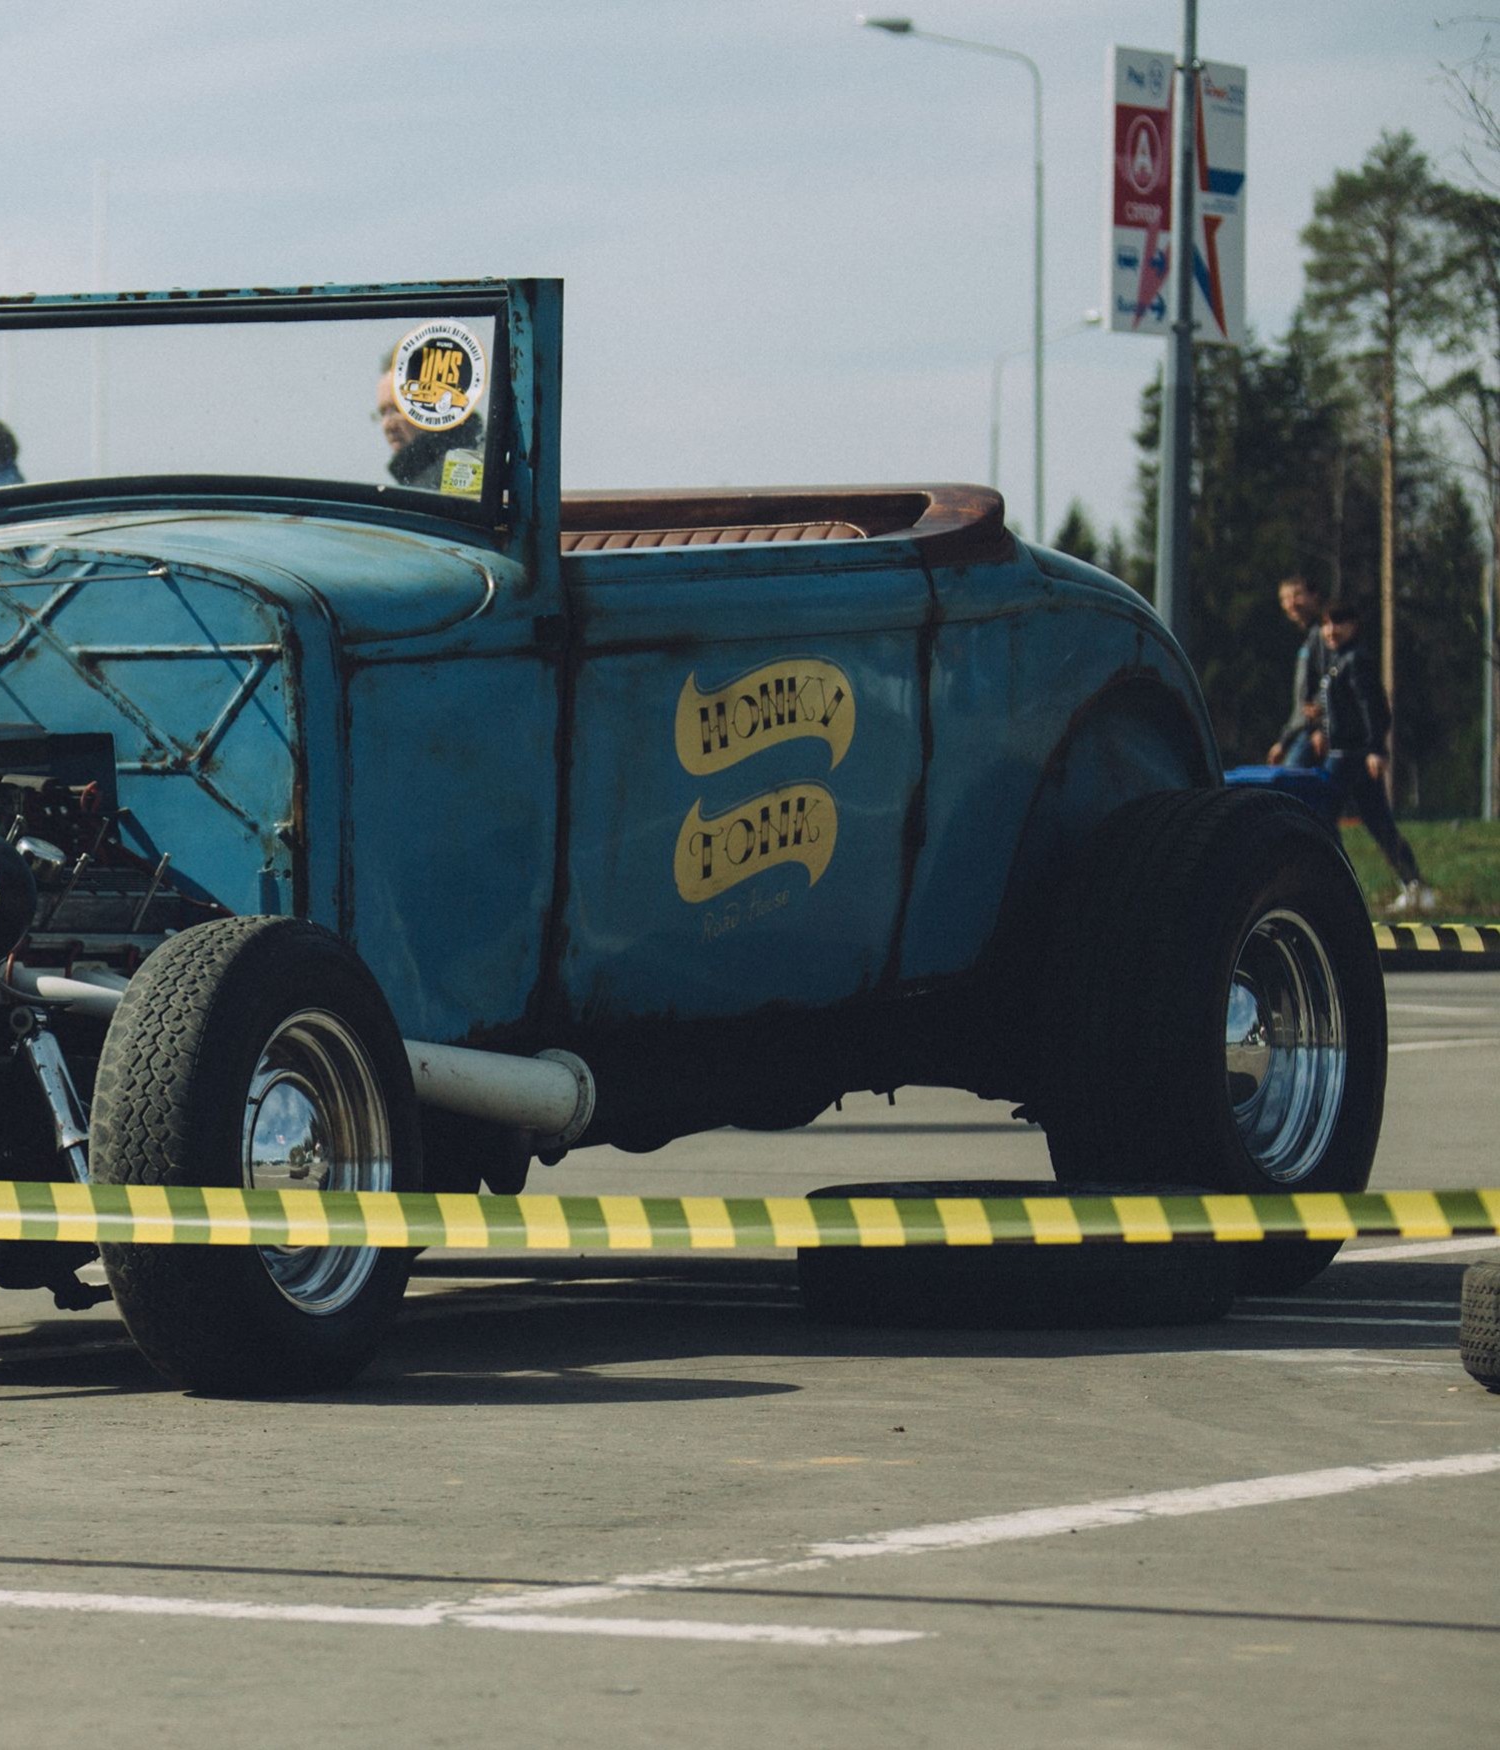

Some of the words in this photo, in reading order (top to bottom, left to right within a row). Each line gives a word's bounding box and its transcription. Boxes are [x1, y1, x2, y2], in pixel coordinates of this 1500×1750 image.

[419, 346, 463, 385] UMS
[697, 676, 846, 755] HONKY
[689, 797, 822, 880] TONK
